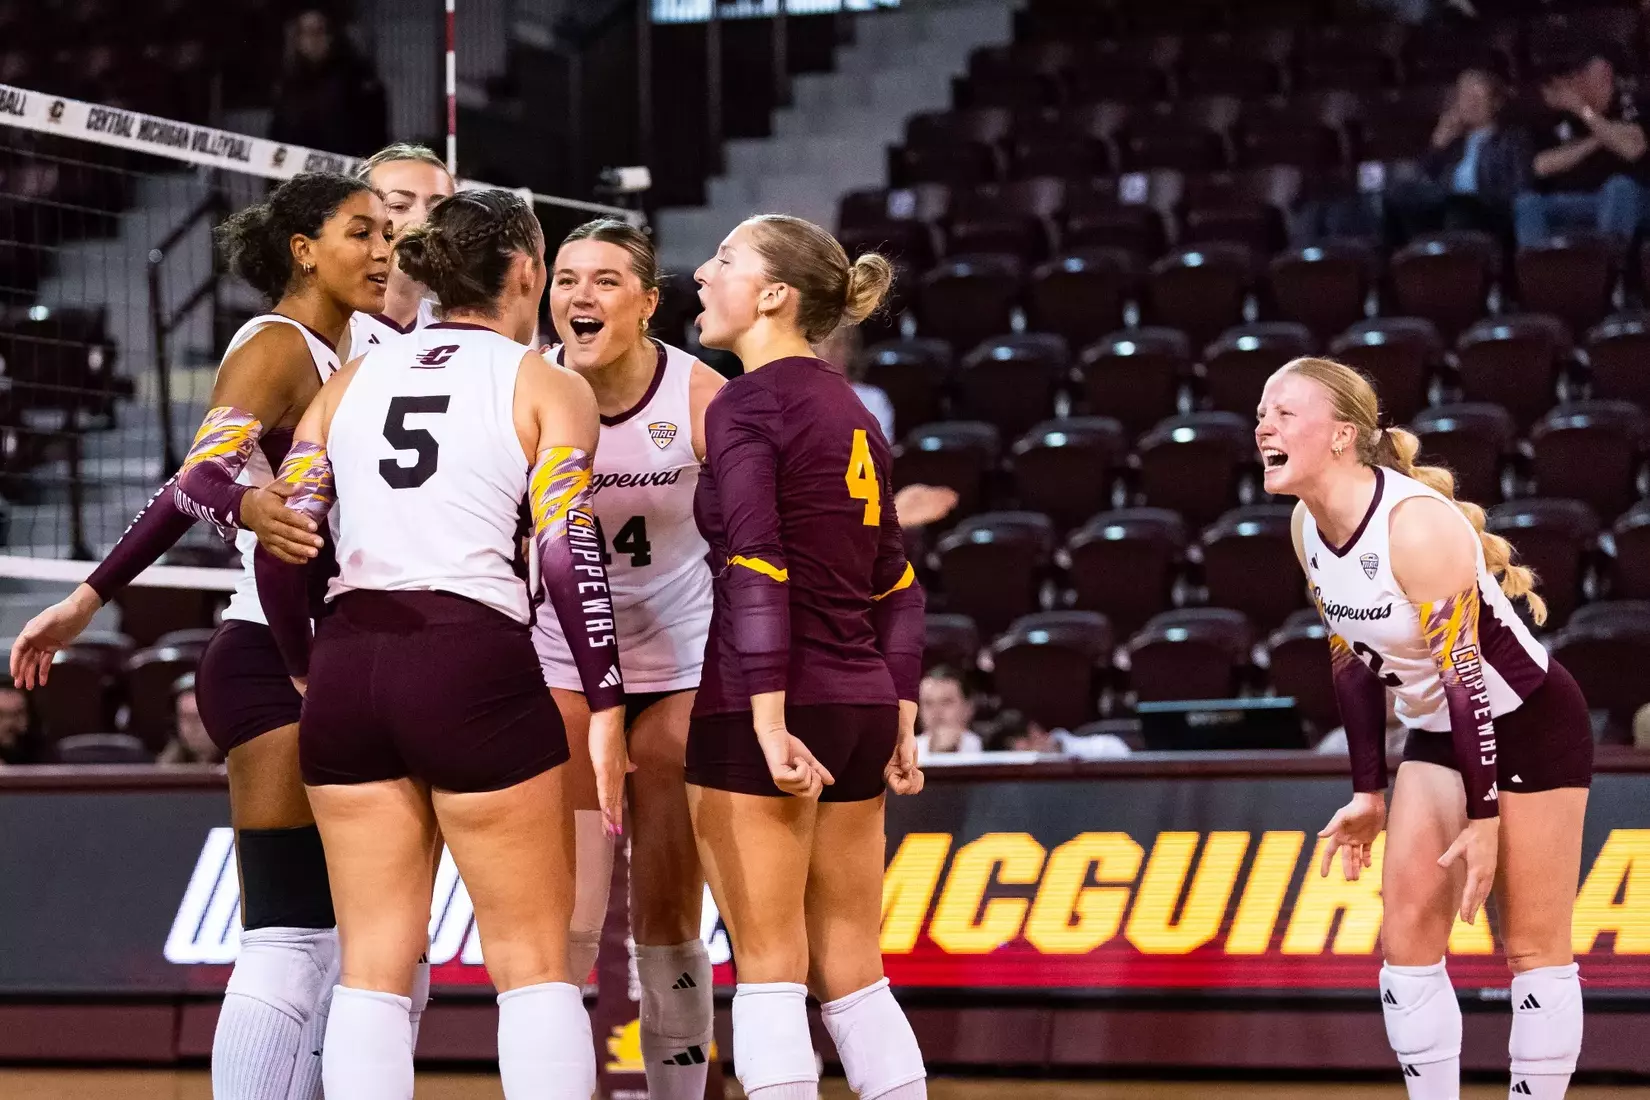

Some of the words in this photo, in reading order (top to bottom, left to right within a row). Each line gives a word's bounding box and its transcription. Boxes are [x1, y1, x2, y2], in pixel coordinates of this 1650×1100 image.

[379, 395, 451, 489] 5
[845, 428, 881, 527] 4
[567, 509, 616, 649] CHIPPEWAS
